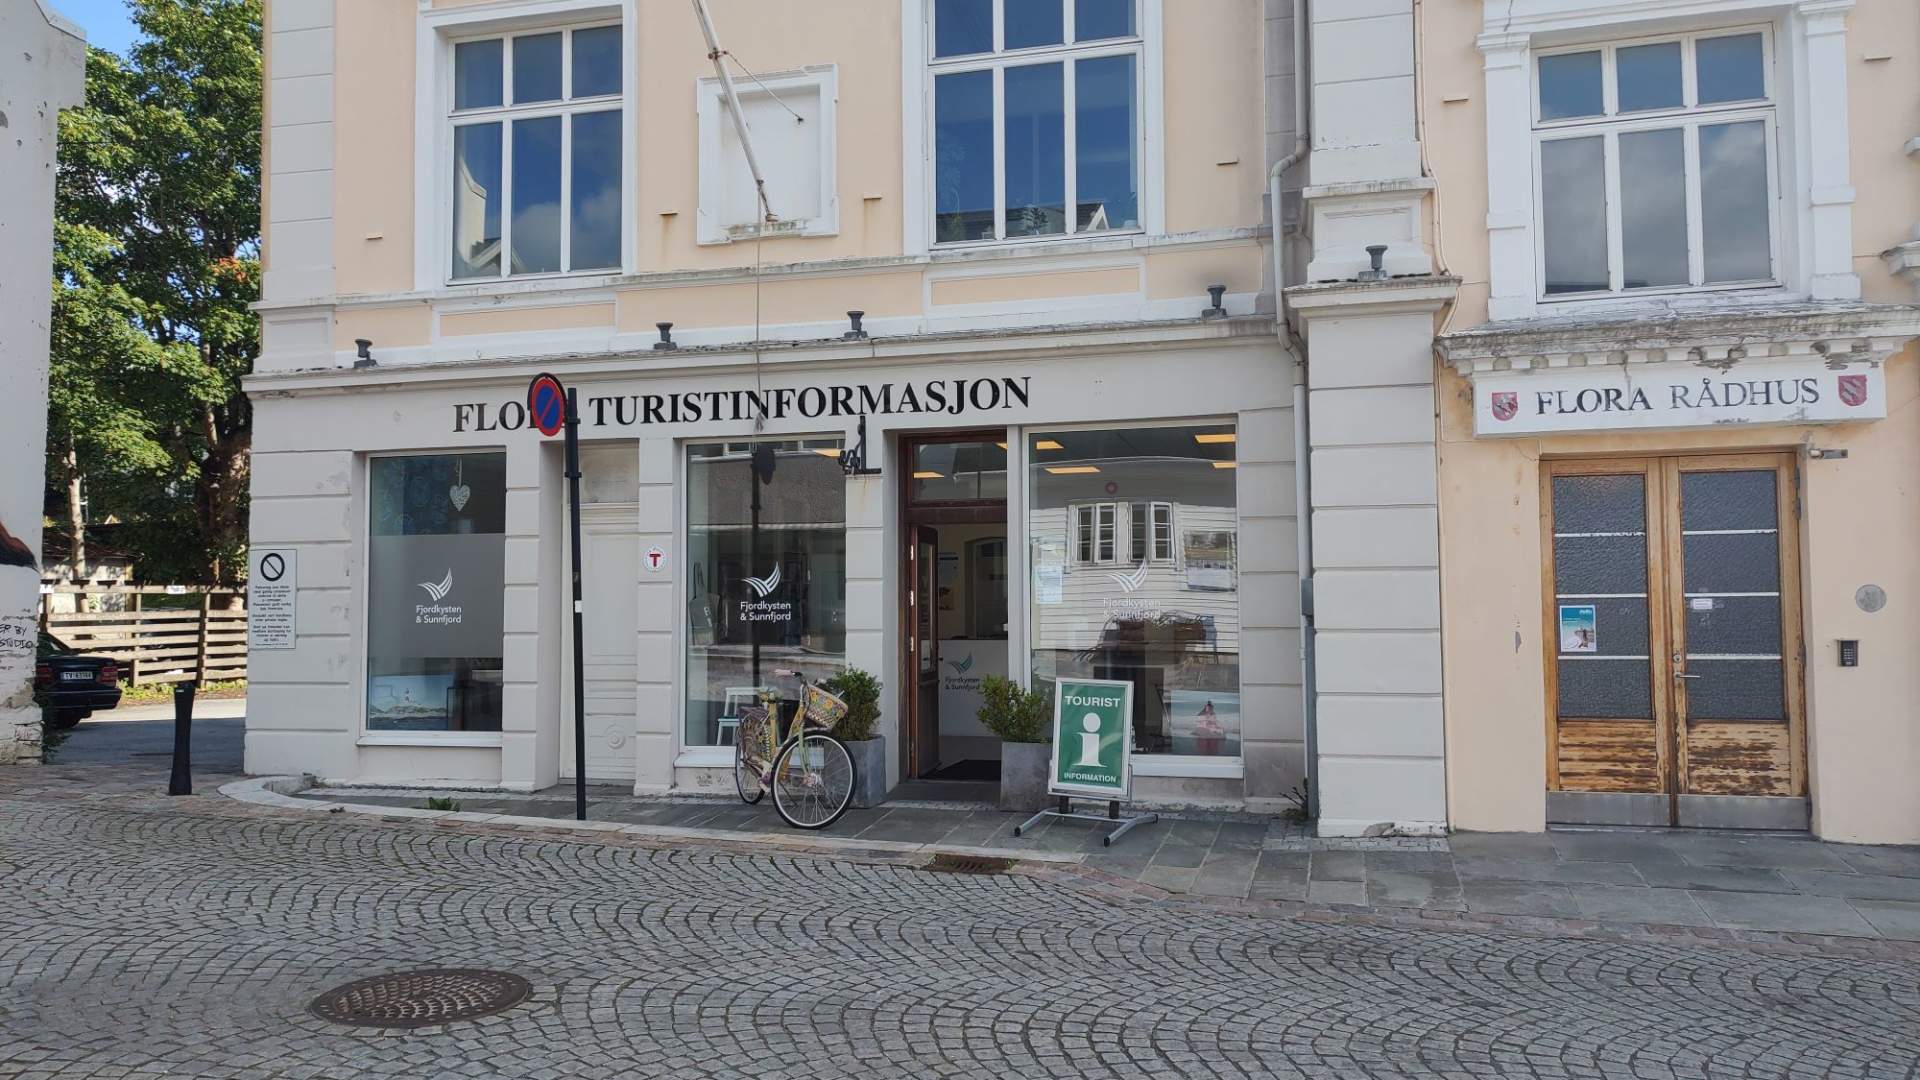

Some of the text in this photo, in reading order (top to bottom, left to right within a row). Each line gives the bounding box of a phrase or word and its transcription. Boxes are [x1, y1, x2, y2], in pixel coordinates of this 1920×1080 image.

[1535, 377, 1820, 415] FLORA RÅDHUS
[453, 376, 1032, 433] FLO TURISTINFORMASJON
[416, 604, 462, 616] Fjordkysten
[740, 600, 791, 612] Fjordkysten
[415, 614, 462, 626] & Sunnfjord
[740, 611, 792, 623] & Sunnfjord
[1064, 695, 1121, 708] TOURIST
[1063, 771, 1117, 783] INFORMATION
